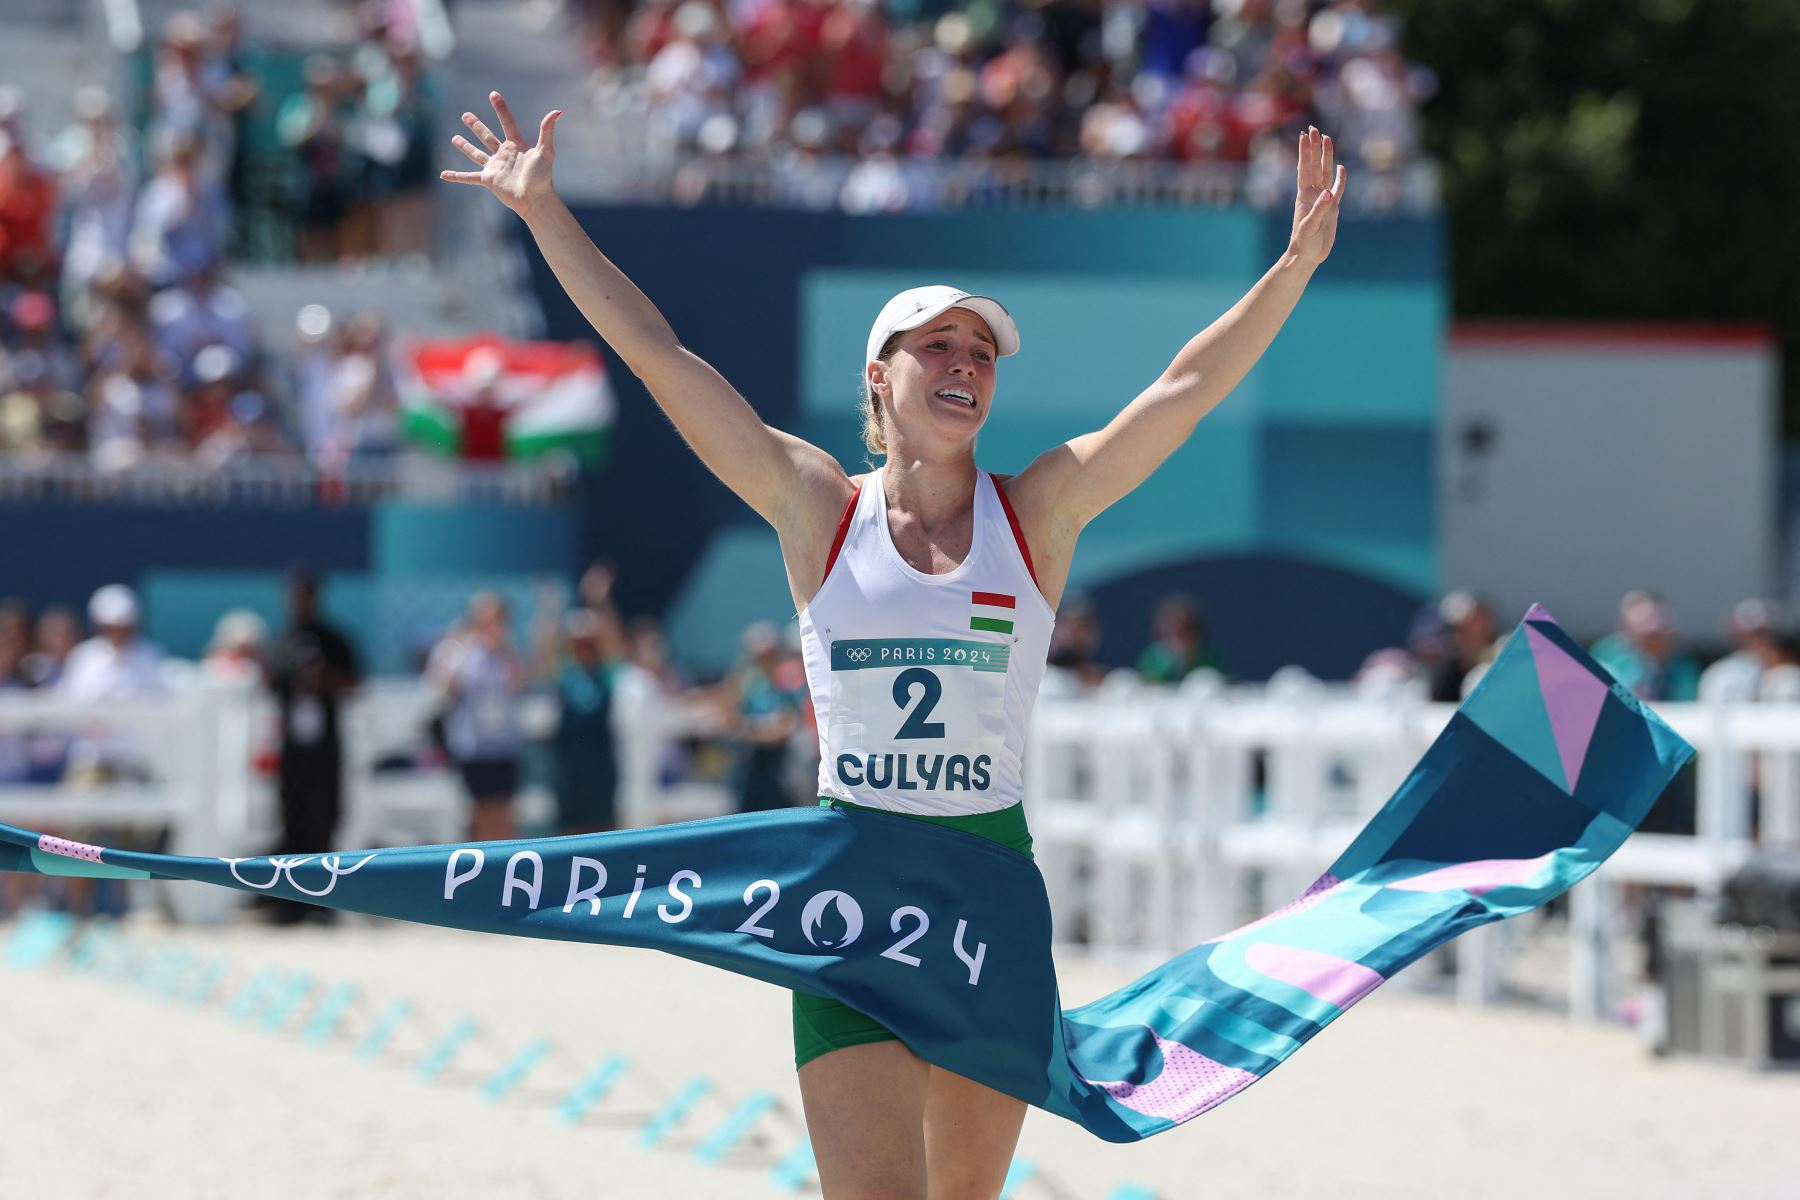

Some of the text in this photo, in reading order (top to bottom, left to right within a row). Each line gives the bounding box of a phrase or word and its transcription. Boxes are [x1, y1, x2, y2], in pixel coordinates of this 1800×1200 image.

[943, 647, 990, 664] 2024
[892, 667, 945, 739] 2
[734, 879, 987, 986] 2024
